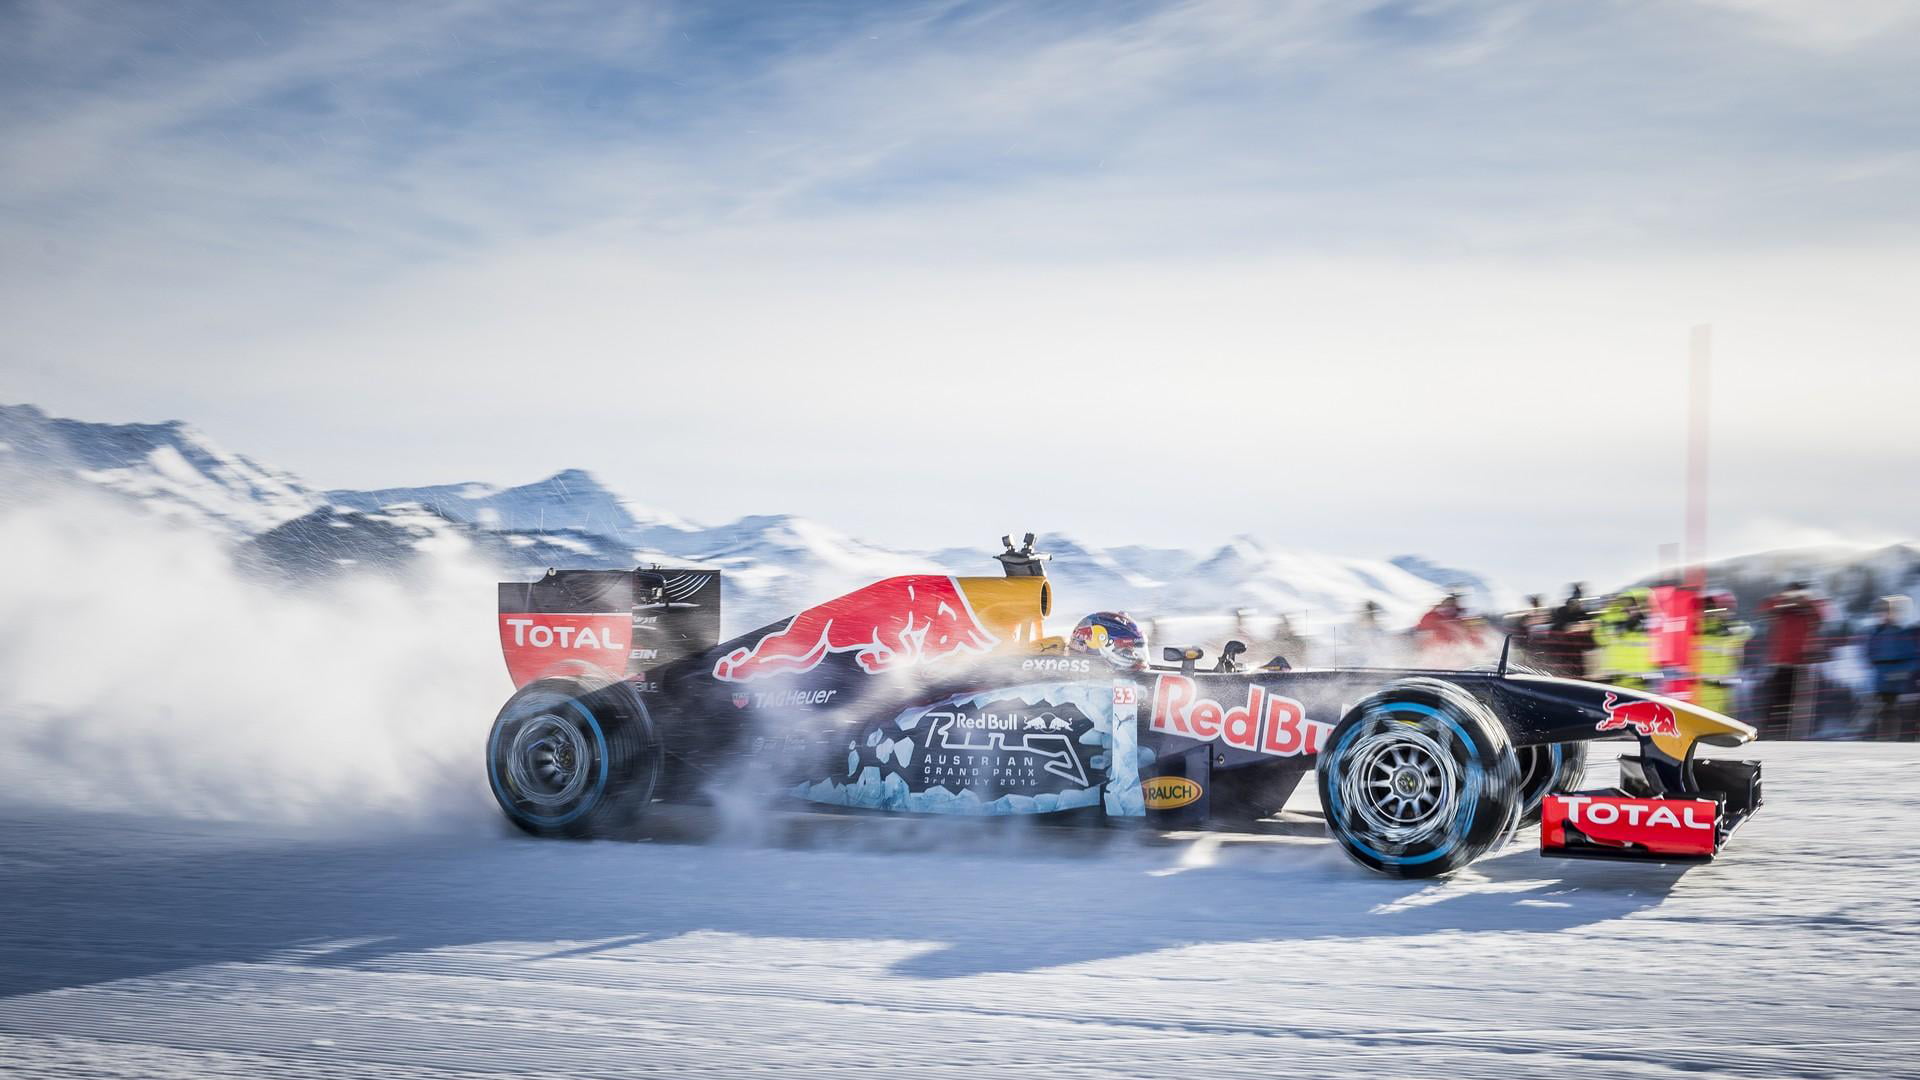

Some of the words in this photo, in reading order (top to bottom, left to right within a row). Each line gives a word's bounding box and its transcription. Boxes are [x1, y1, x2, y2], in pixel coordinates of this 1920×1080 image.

[506, 619, 624, 649] TOTAL
[1021, 658, 1090, 673] exness
[1114, 686, 1136, 704] 33
[1150, 674, 1265, 752] Red
[956, 712, 986, 729] Red
[987, 713, 1018, 731] Bull
[924, 754, 1034, 766] AUSTRIAN
[924, 766, 980, 776] GRAND
[993, 768, 1034, 777] PRIX
[924, 776, 946, 785] 3rd
[955, 778, 991, 786] JULY
[1000, 778, 1036, 787] 2016
[1148, 785, 1192, 799] RAUCH
[1557, 796, 1711, 829] TOTAL
